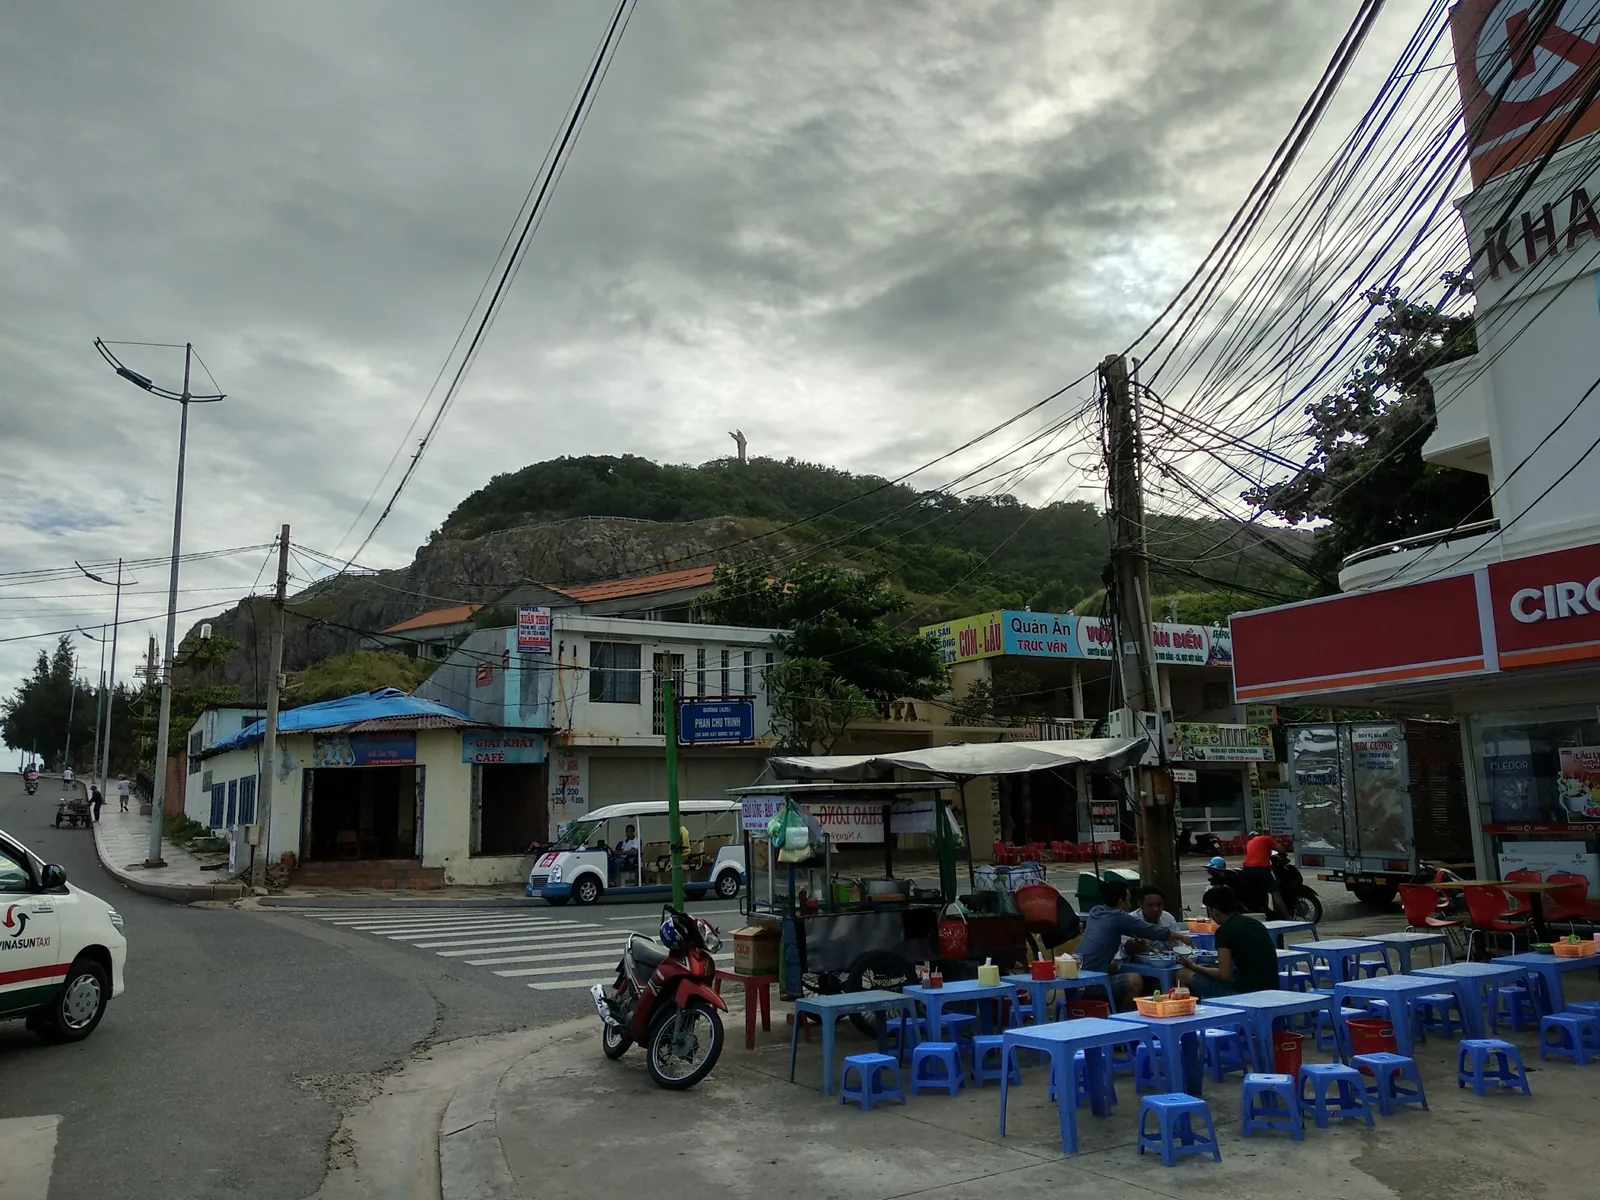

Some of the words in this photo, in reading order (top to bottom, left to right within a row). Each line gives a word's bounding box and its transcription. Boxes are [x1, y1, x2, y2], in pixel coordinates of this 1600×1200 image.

[1011, 618, 1048, 635] Quán
[1052, 617, 1071, 636] Ăn
[695, 718, 710, 728] PHAN
[711, 718, 723, 728] CHU
[724, 717, 741, 727] TRINH
[476, 751, 504, 762] CAFÉ
[567, 788, 579, 796] 200
